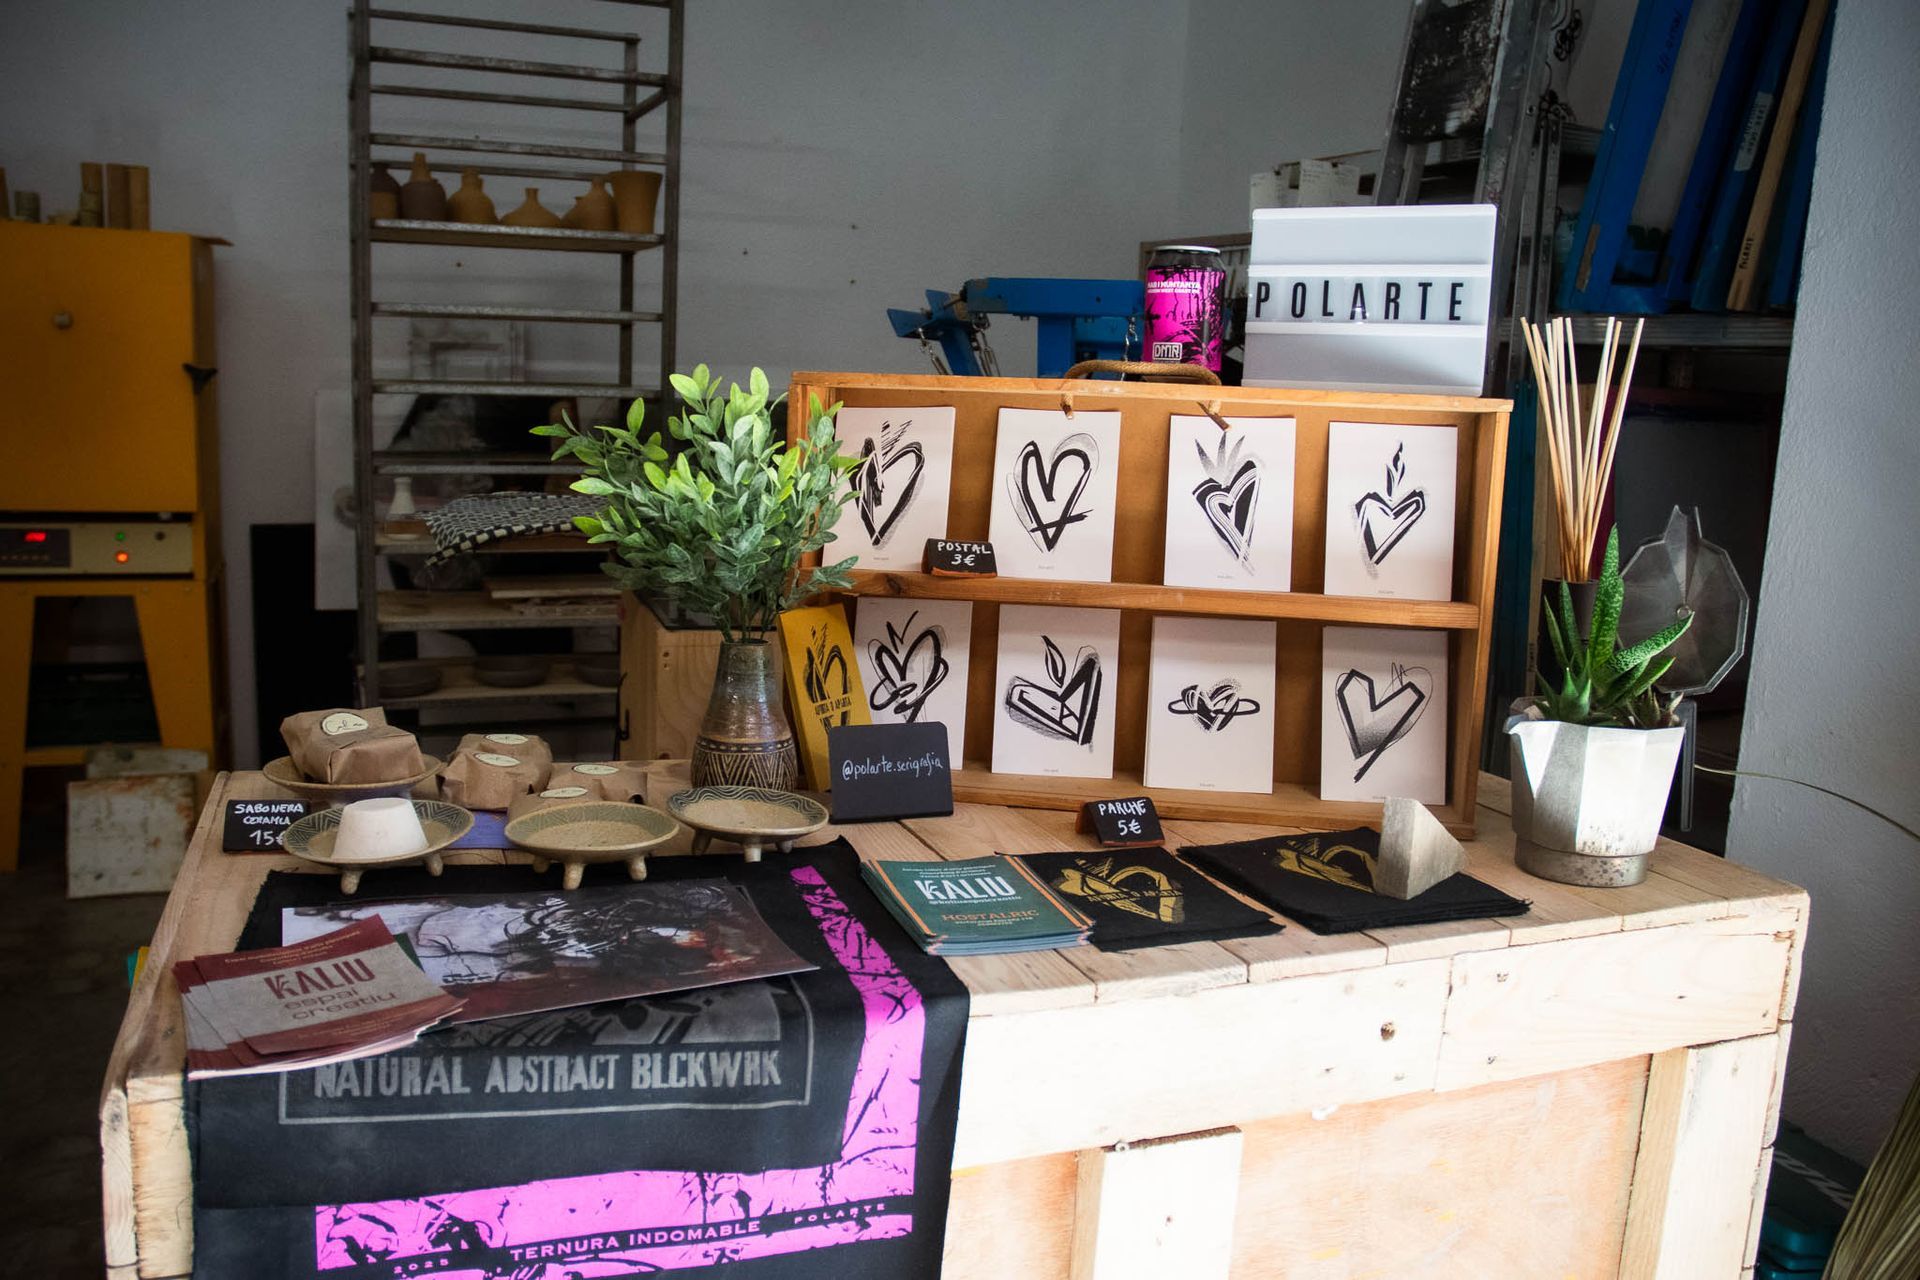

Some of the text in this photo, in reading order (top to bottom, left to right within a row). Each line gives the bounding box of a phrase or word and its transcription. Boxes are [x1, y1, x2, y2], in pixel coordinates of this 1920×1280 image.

[1255, 279, 1464, 322] POLARTE
[937, 541, 991, 554] POSTAL
[951, 554, 976, 566] 3€
[842, 751, 943, 781] @polarte.serigrafia
[234, 802, 304, 814] SABONERA
[1098, 799, 1147, 816] PARCHE
[1117, 819, 1142, 836] 5€
[914, 876, 1016, 900] KALIU
[263, 958, 376, 1000] KALIU
[284, 987, 359, 1010] espai
[292, 992, 397, 1020] creatiu
[314, 1050, 782, 1098] NATURAL ABSTRACT BLCKWRK
[394, 1203, 885, 1274] 2025 TERNURA INDOMABLE POLARTE
